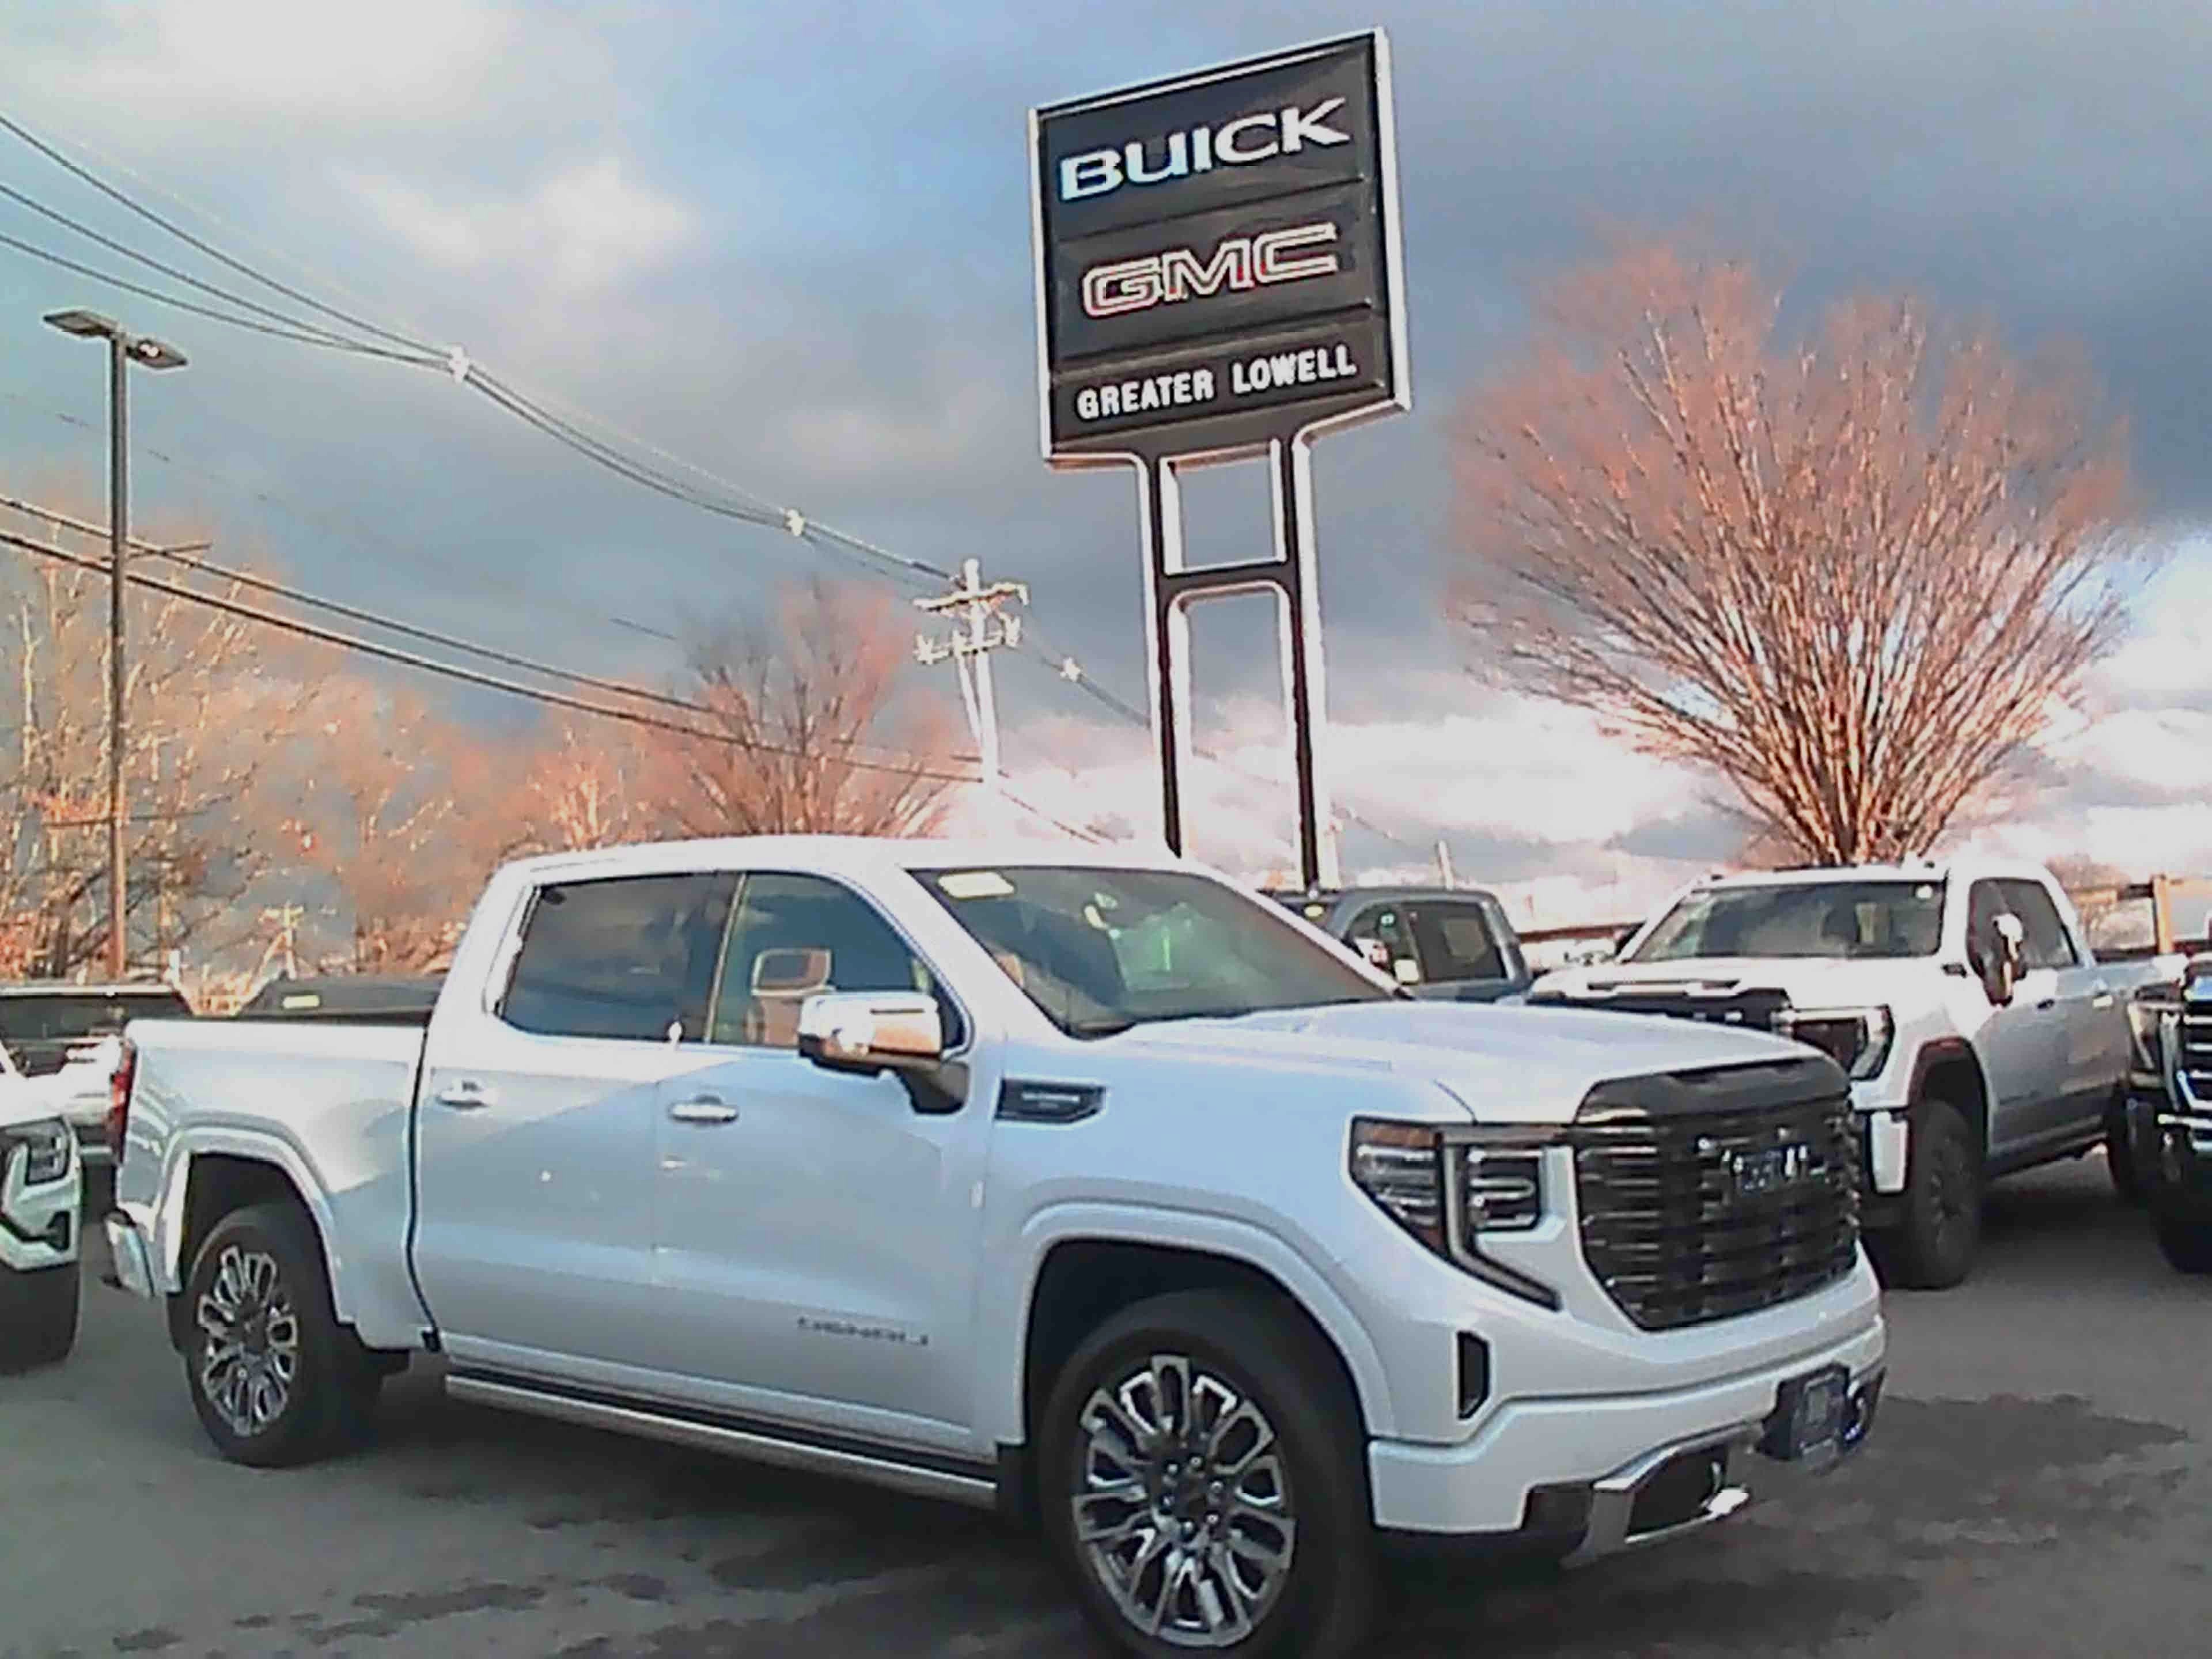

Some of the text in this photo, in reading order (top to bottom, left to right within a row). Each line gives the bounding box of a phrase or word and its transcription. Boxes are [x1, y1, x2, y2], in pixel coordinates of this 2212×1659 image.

[1059, 96, 1351, 201] BUICK
[1082, 221, 1341, 318] GMC
[1076, 344, 1358, 420] GREATER LOWELL
